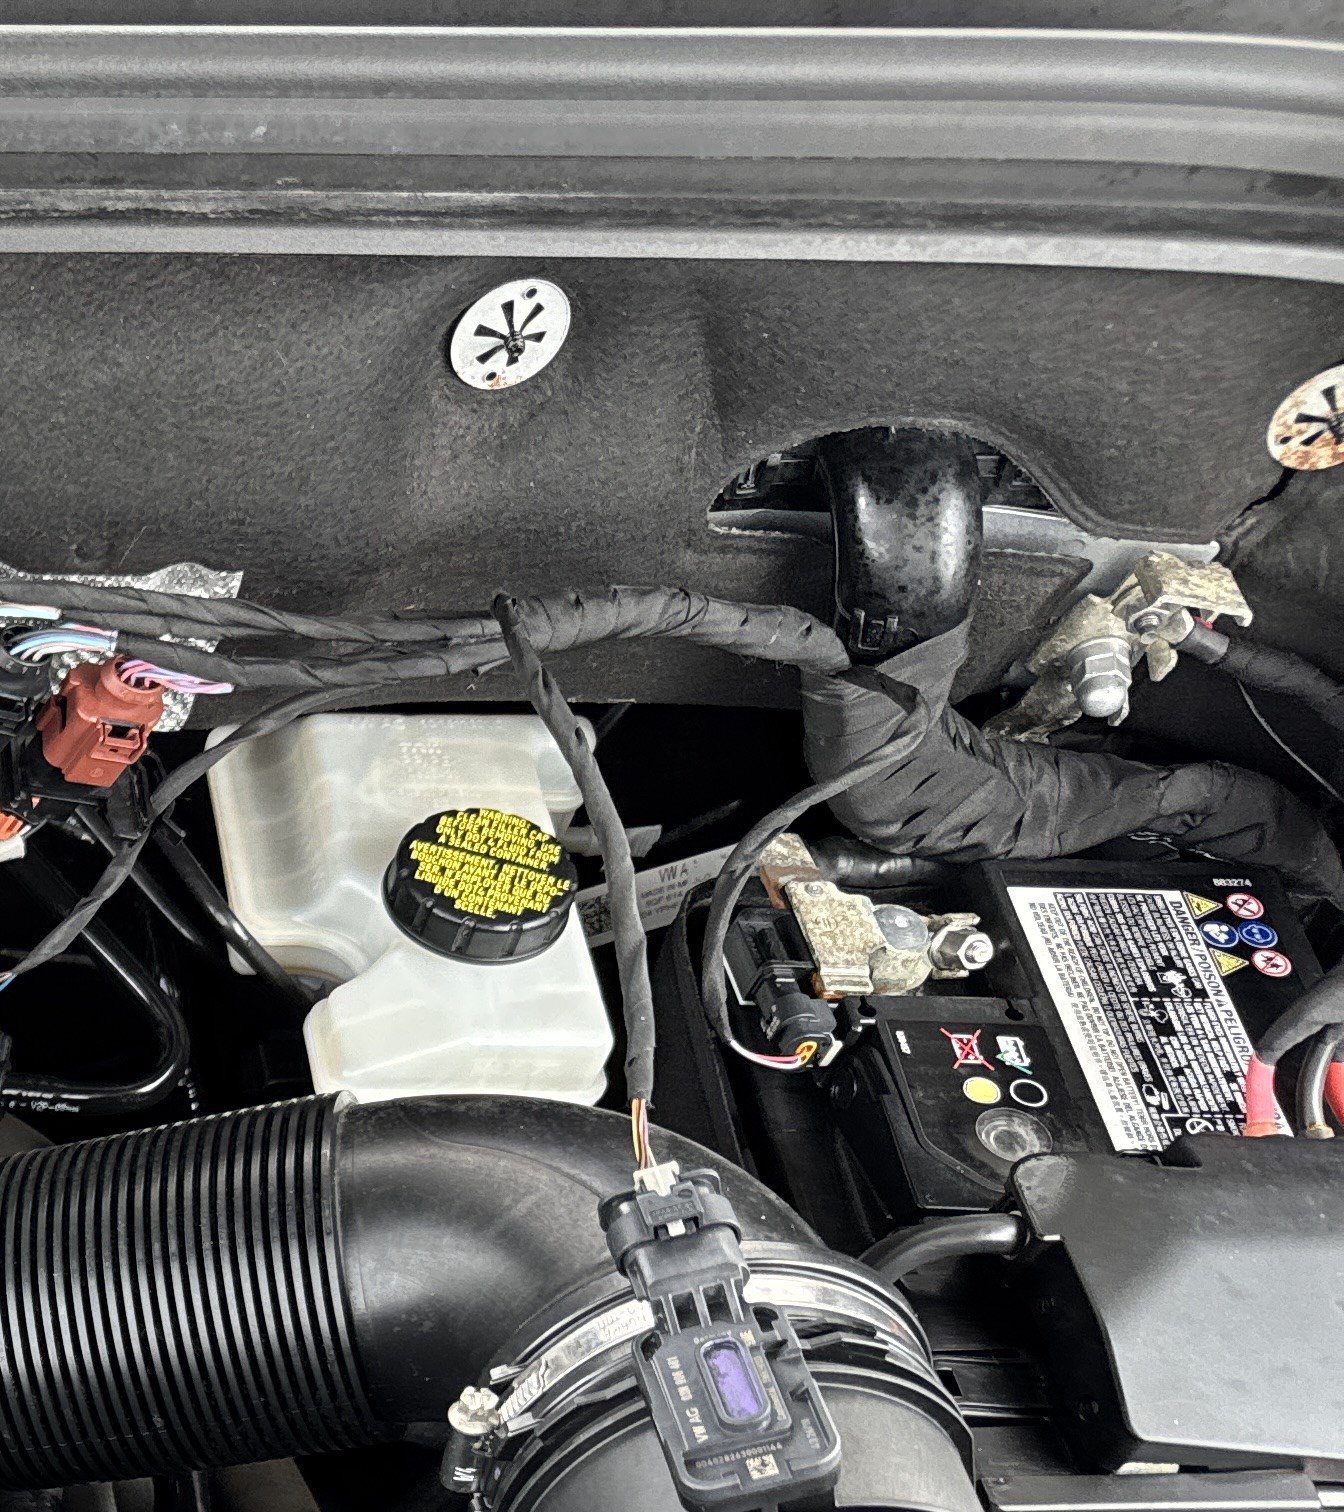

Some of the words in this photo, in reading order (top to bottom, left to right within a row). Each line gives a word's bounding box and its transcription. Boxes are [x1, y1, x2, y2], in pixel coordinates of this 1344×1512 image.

[491, 818, 527, 835] FILLER
[530, 828, 550, 841] CAP
[436, 824, 464, 837] ONLY
[530, 848, 560, 864] FROM
[438, 834, 446, 843] A
[448, 837, 488, 854] SEALED
[540, 843, 562, 855] USE
[410, 850, 461, 870] BOUCHON
[463, 862, 497, 879] AVANT
[498, 873, 512, 884] DE
[514, 878, 527, 888] LE
[414, 870, 456, 889] LIQUIDE
[487, 888, 550, 913] PROVENANT
[512, 884, 533, 897] QUE
[535, 892, 552, 904] DU
[557, 879, 570, 891] LE
[461, 892, 524, 916] CONTENANT
